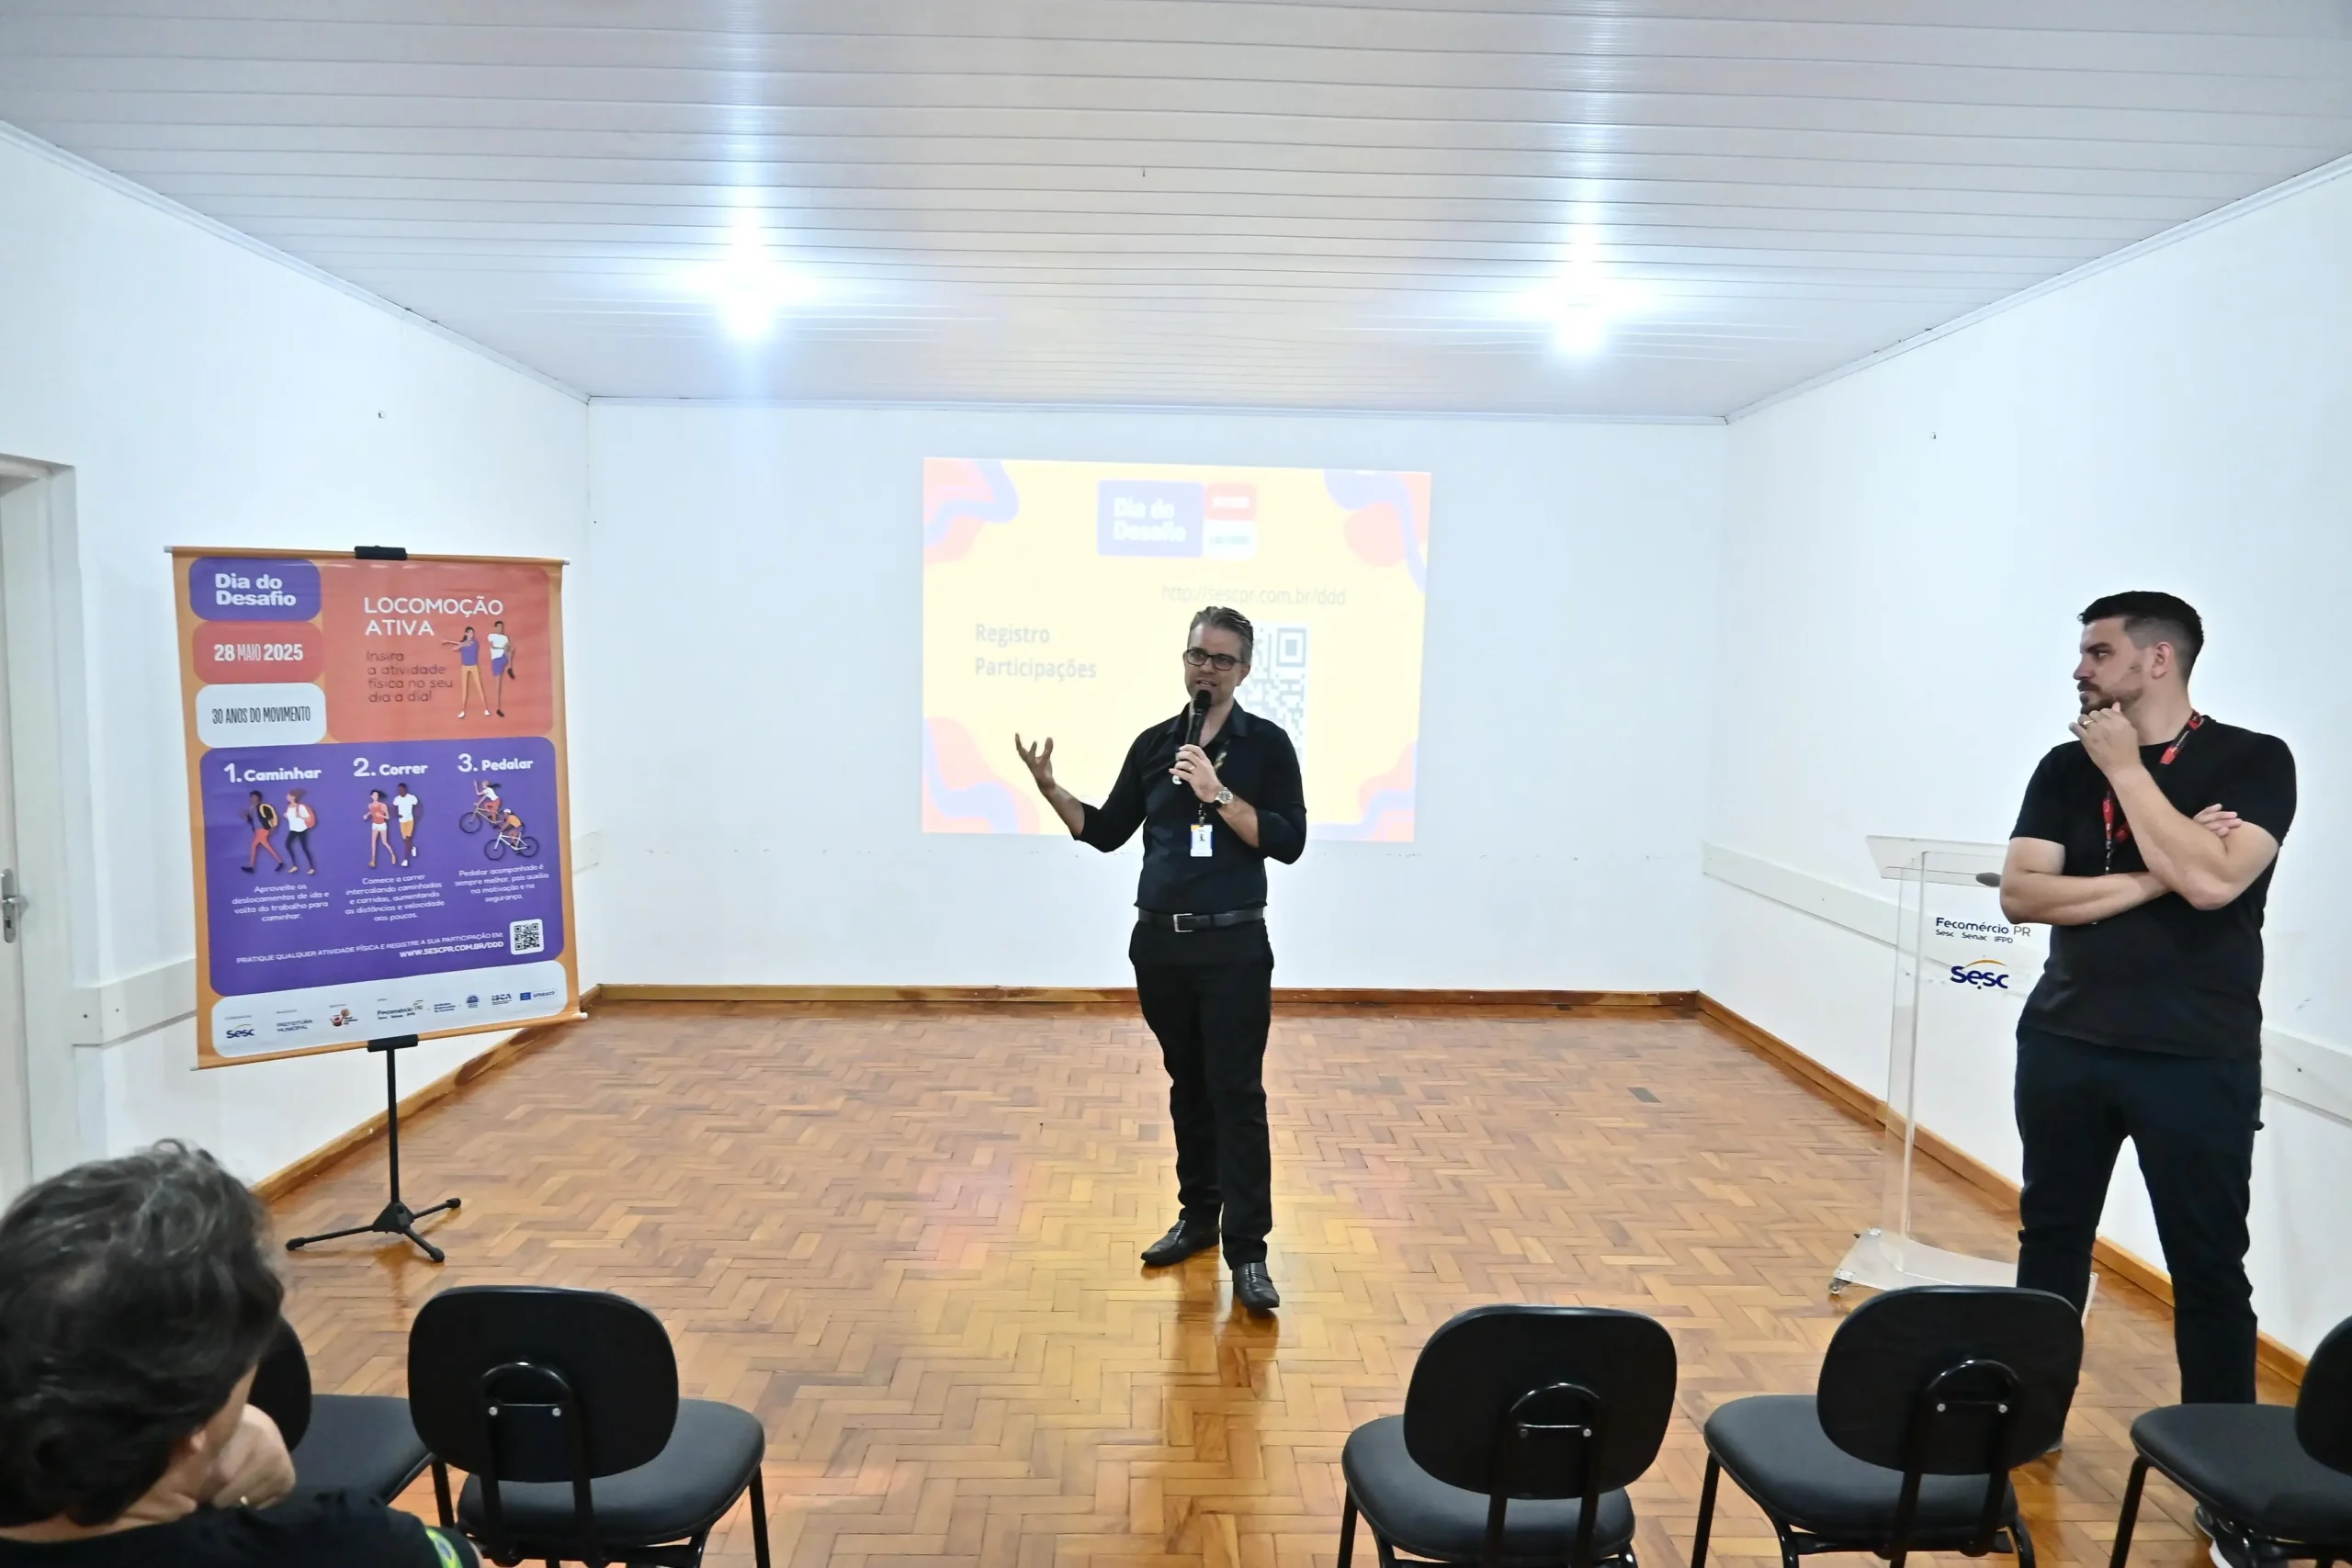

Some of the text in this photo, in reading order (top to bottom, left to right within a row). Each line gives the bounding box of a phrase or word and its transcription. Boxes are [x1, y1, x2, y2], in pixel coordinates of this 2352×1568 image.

[215, 573, 283, 590] Dia do
[216, 591, 297, 606] Desafio
[364, 596, 503, 617] LOCOMOÇÃO
[365, 619, 435, 636] ATIVA
[975, 623, 1050, 649] Registro
[214, 644, 303, 661] 28 MAIO 2025
[367, 650, 405, 661] Insira
[368, 664, 447, 675] a atividade
[975, 657, 1097, 682] Participações
[368, 678, 453, 689] física no seu
[368, 692, 390, 703] dia
[394, 694, 404, 702] a
[212, 705, 311, 724] 30 ANOS DO MOVIMENTO
[353, 757, 428, 777] 2. Correr
[458, 753, 534, 773] 3. Pedalar
[223, 762, 322, 784] 1. Caminhar
[490, 864, 538, 874] acompanhado
[254, 885, 296, 894] Aproveite
[345, 886, 397, 896] intercalando
[392, 891, 440, 902] aumentando
[232, 894, 295, 905] deslocamentos
[271, 902, 307, 911] trabalho
[309, 901, 329, 909] para
[1936, 917, 2031, 937] Fecomércio PR
[1935, 929, 2014, 943] Sesc Senac IFPD
[236, 954, 276, 964] PRATIQUE
[276, 950, 317, 960] QUALQUER
[317, 946, 355, 956] ATIVIDADE
[356, 943, 379, 952] FÍSICA
[386, 939, 420, 949] REGISTRE
[441, 932, 491, 943] PARTICIPAÇÃO
[399, 941, 504, 958] WWW.SESCPR.COM.BR/DDD
[1950, 965, 2009, 989] Sesc
[226, 1028, 255, 1039] Sesc
